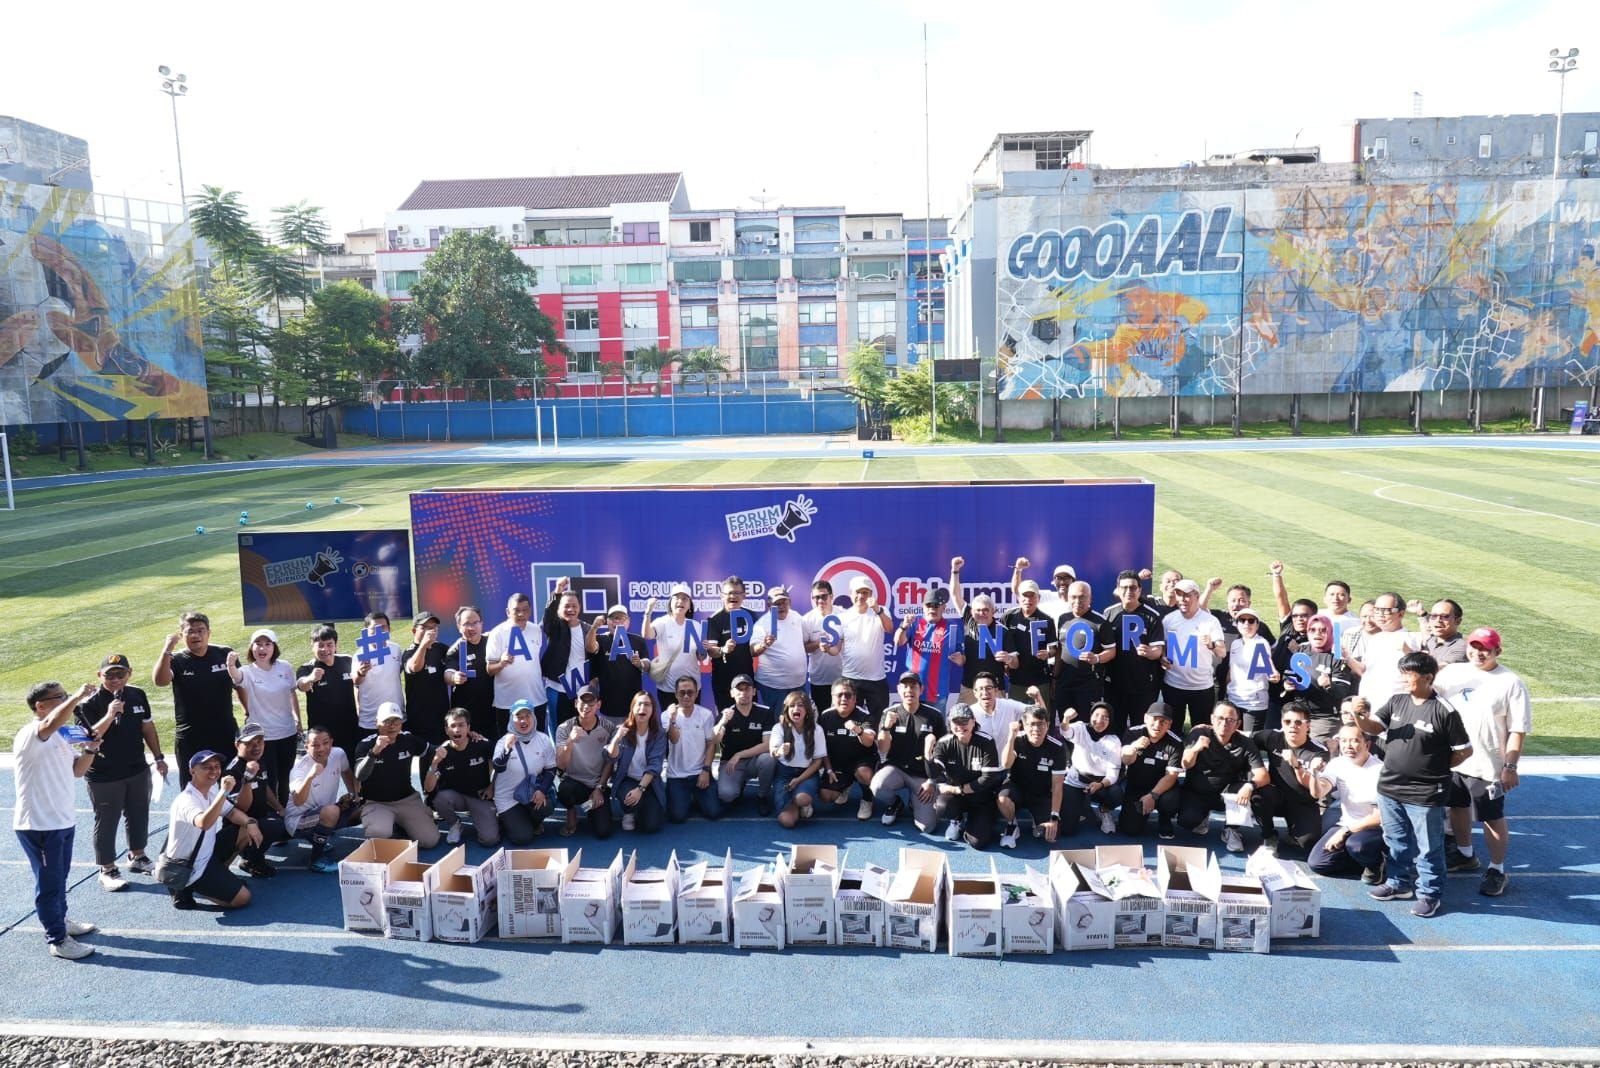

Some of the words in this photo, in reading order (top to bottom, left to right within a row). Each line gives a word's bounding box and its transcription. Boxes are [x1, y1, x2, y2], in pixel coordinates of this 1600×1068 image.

[1008, 204, 1242, 281] GOOOAAL
[728, 507, 780, 524] FORUM
[730, 517, 777, 532] PEMRED
[266, 558, 311, 574] FORUM
[268, 567, 309, 580] PEMRED
[631, 583, 675, 596] FORU
[695, 583, 763, 596] PEMED
[459, 639, 477, 678] L
[508, 625, 532, 661] A
[609, 625, 635, 661] A
[683, 619, 708, 659] N
[730, 609, 754, 645] D
[820, 615, 842, 647] S
[978, 624, 1003, 660] N
[1030, 620, 1049, 657] F
[1066, 621, 1095, 660] O
[1122, 614, 1146, 652] R
[1166, 631, 1198, 669] M
[1247, 643, 1274, 680] A
[1289, 652, 1312, 691] S
[913, 639, 942, 649] QATAR
